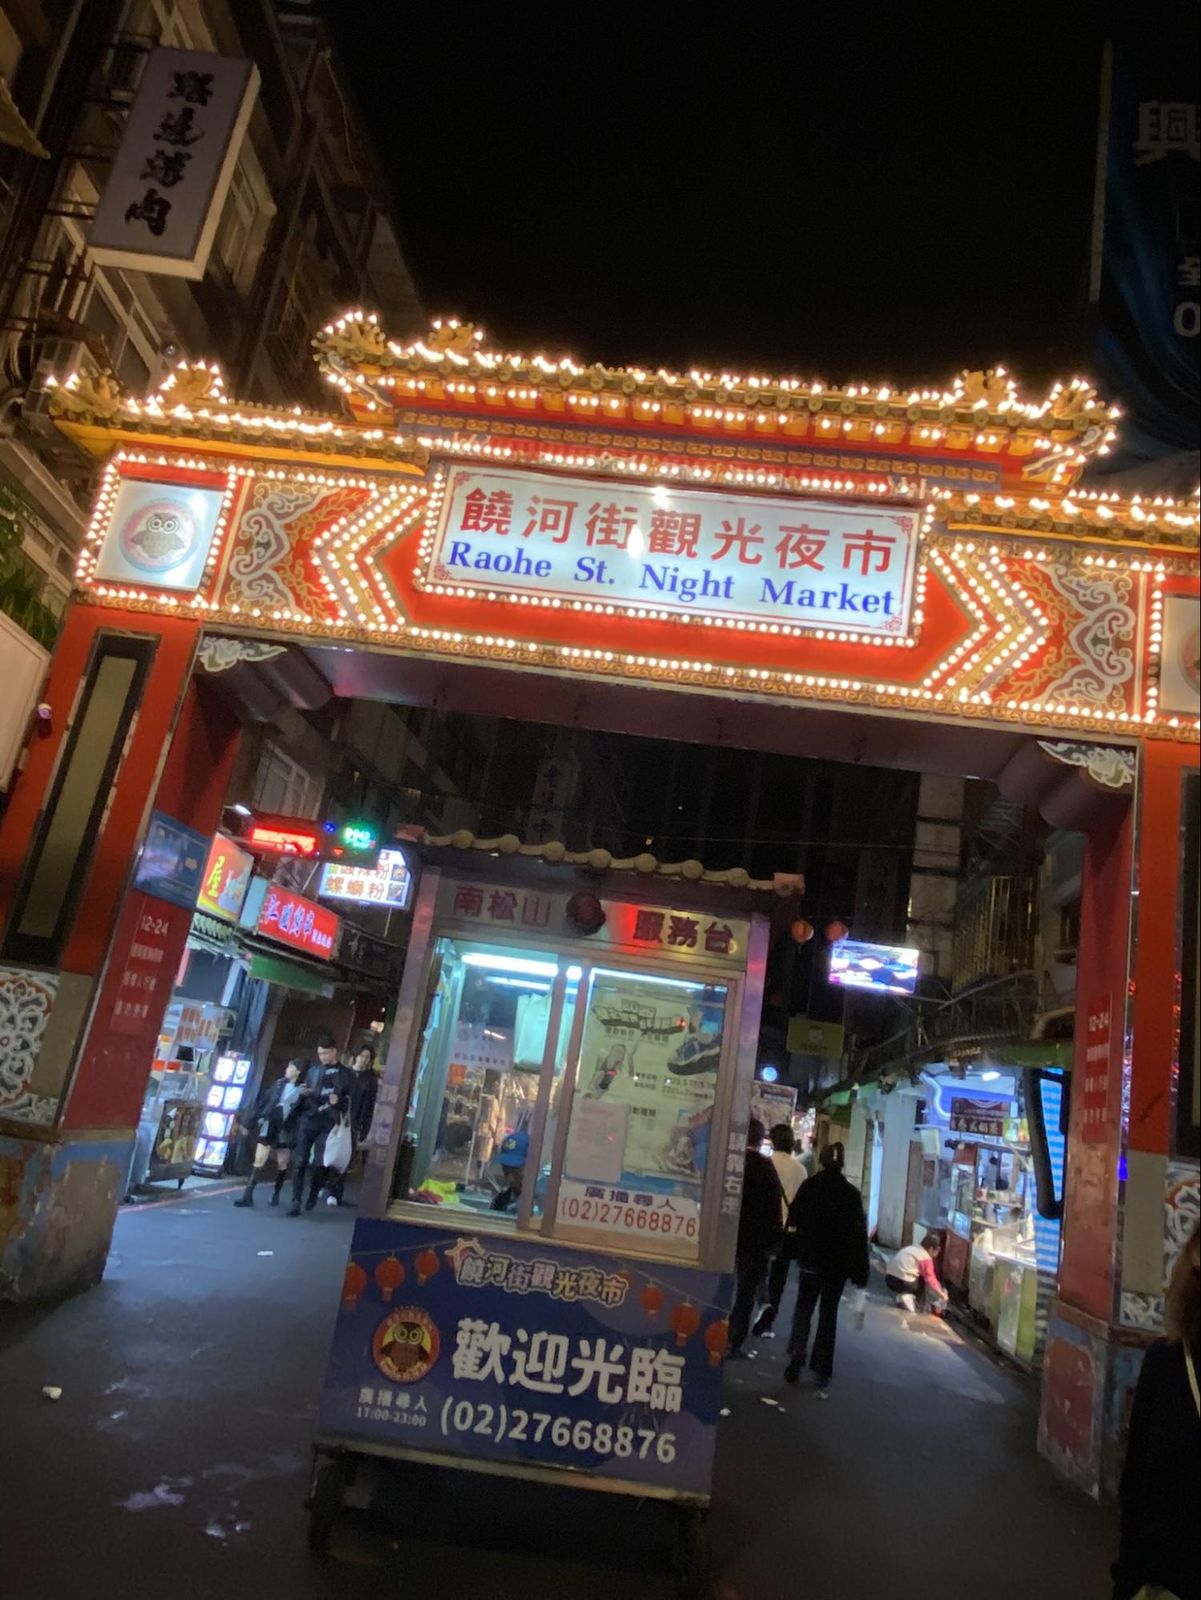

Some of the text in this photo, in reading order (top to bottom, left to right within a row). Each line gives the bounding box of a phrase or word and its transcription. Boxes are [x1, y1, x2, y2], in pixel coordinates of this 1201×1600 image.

[460, 487, 896, 577] 饒河街觀光夜市
[446, 541, 895, 616] Raohe St. Night Market
[453, 885, 552, 927] 南松山
[633, 909, 734, 954] 服務台
[561, 1199, 696, 1237] (02)27668876
[584, 1186, 677, 1211] 廣播尋人
[458, 1255, 628, 1306] 饒河街觀光夜市
[452, 1317, 685, 1413] 歡迎光臨
[440, 1395, 677, 1465] (02)27668876
